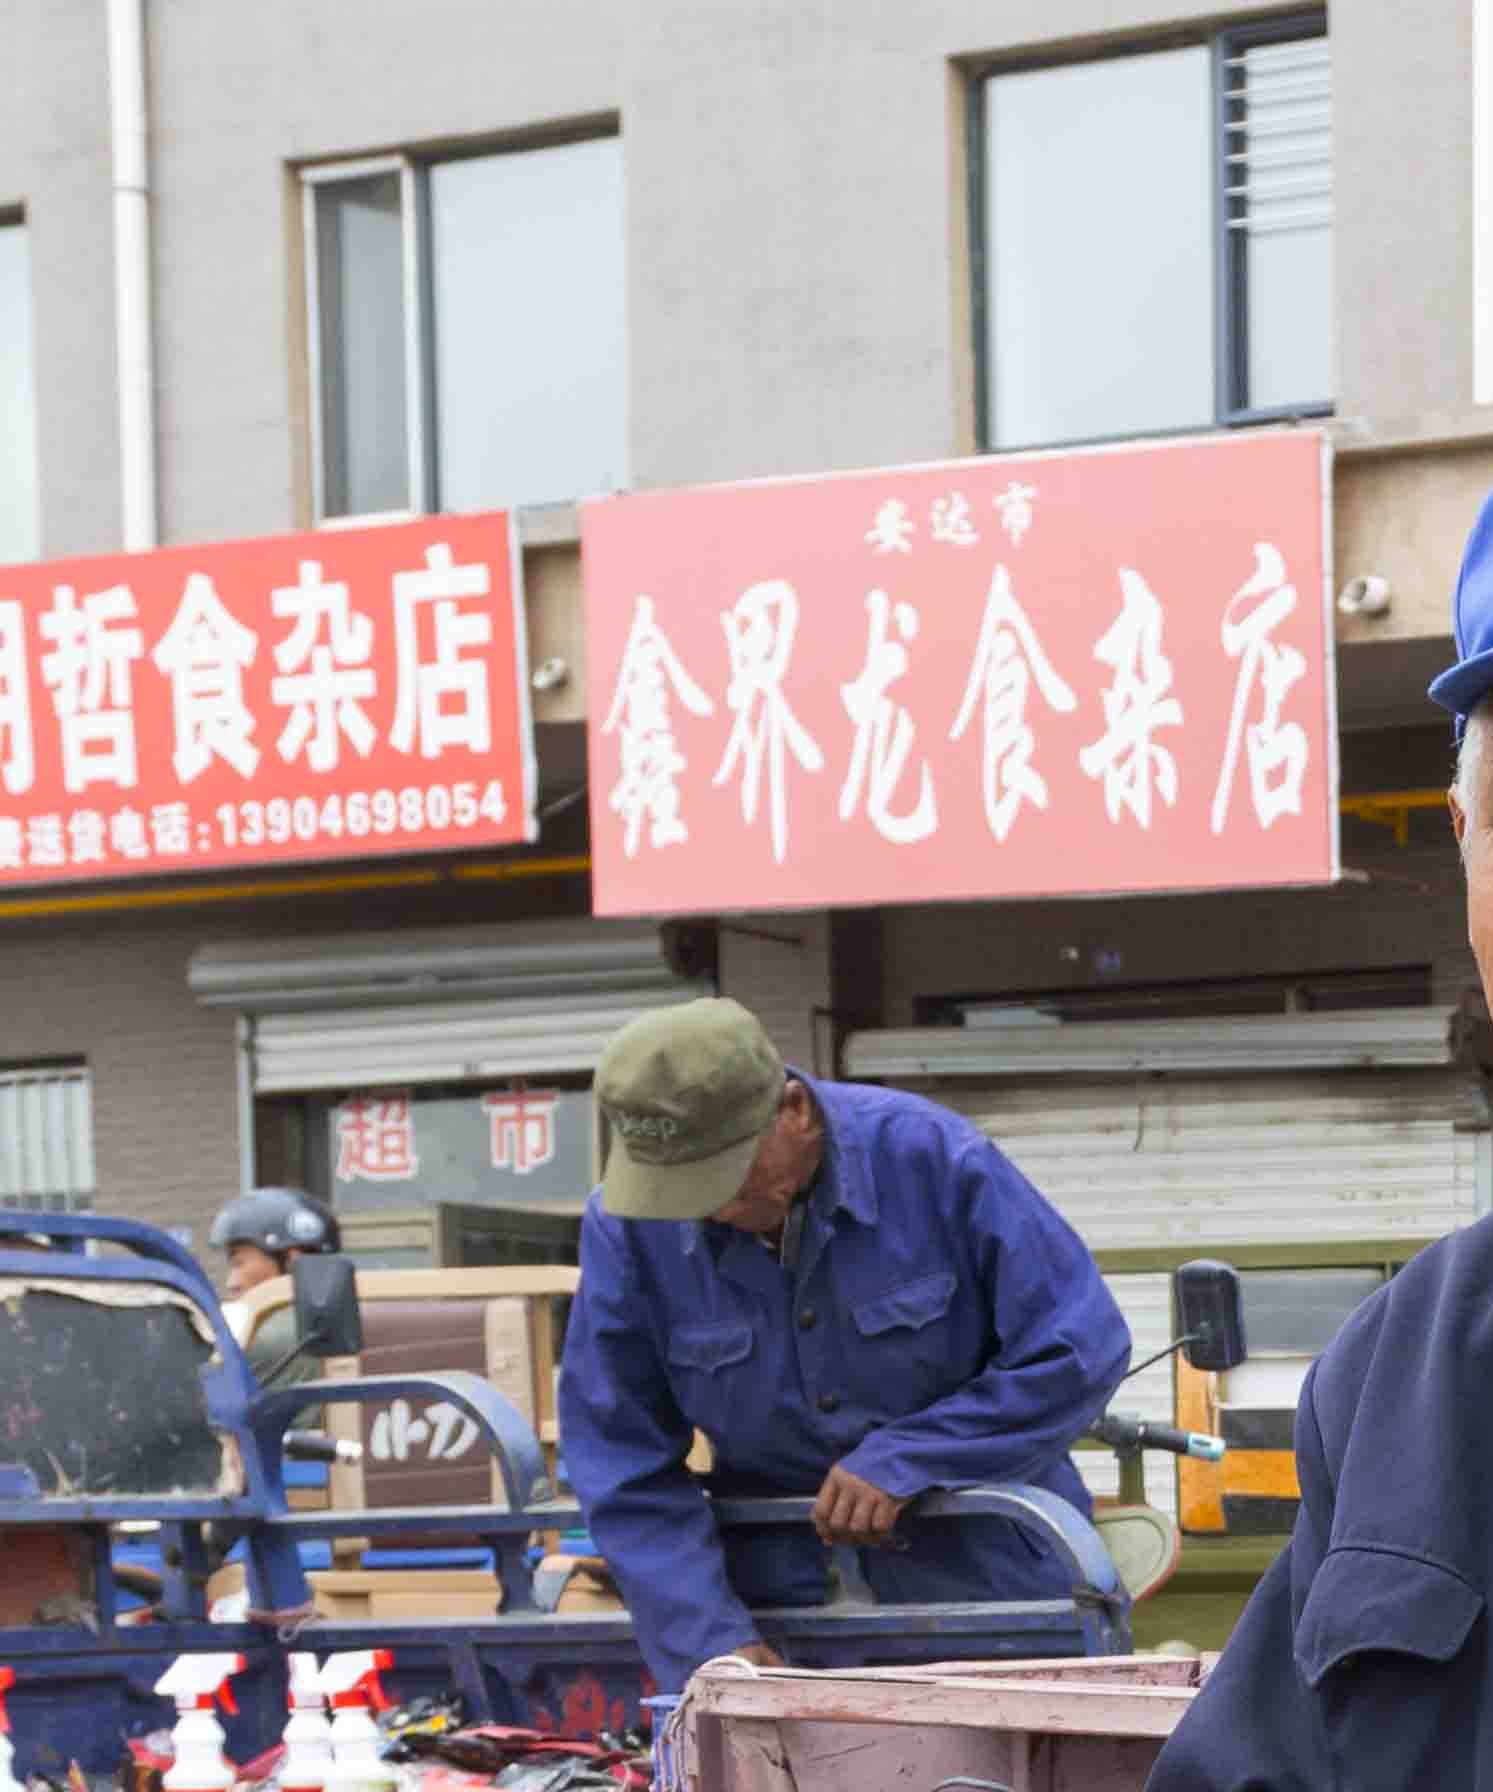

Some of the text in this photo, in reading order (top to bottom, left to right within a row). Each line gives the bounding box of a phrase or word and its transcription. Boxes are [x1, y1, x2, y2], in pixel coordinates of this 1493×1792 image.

[864, 481, 1038, 553] 安达市
[335, 1083, 561, 1183] 超市
